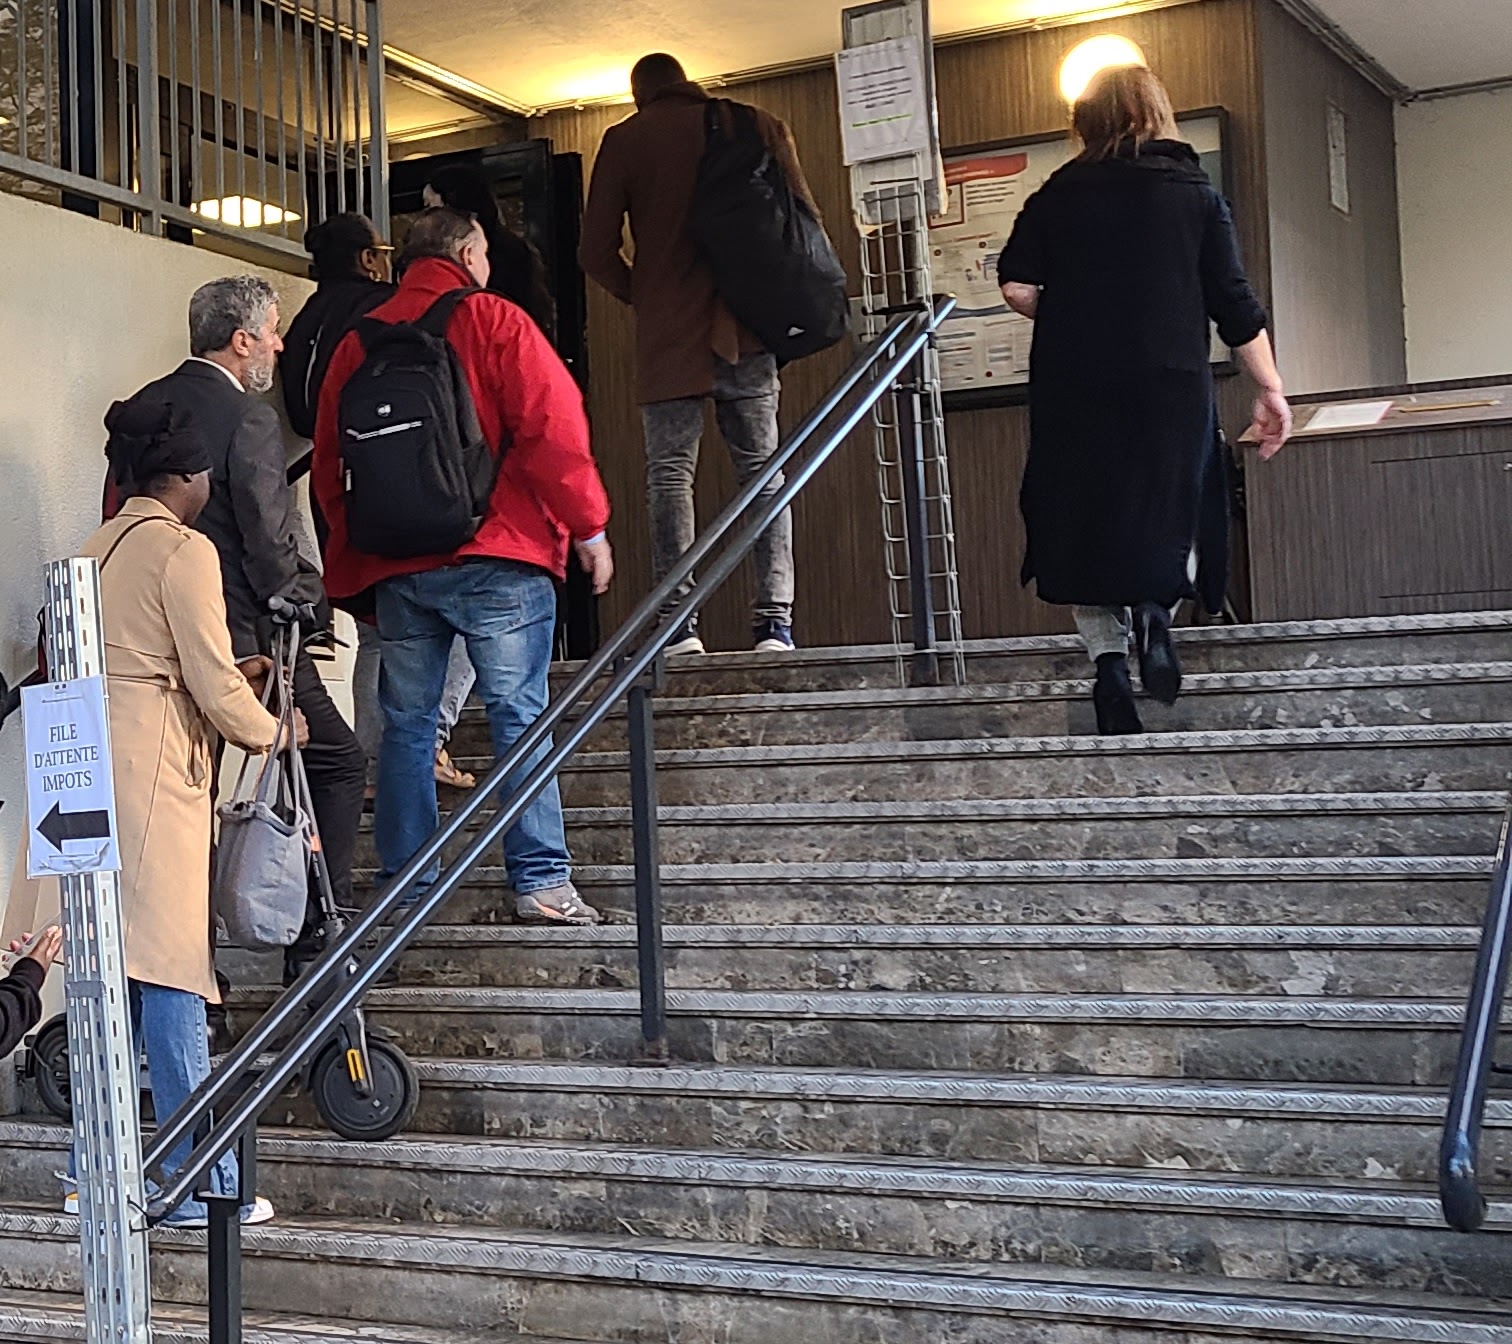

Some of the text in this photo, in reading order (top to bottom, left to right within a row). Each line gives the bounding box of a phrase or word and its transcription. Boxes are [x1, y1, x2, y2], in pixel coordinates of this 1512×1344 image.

[49, 723, 78, 743] FILE
[34, 745, 99, 769] D'ATTENTE
[43, 770, 93, 793] IMPOTS
